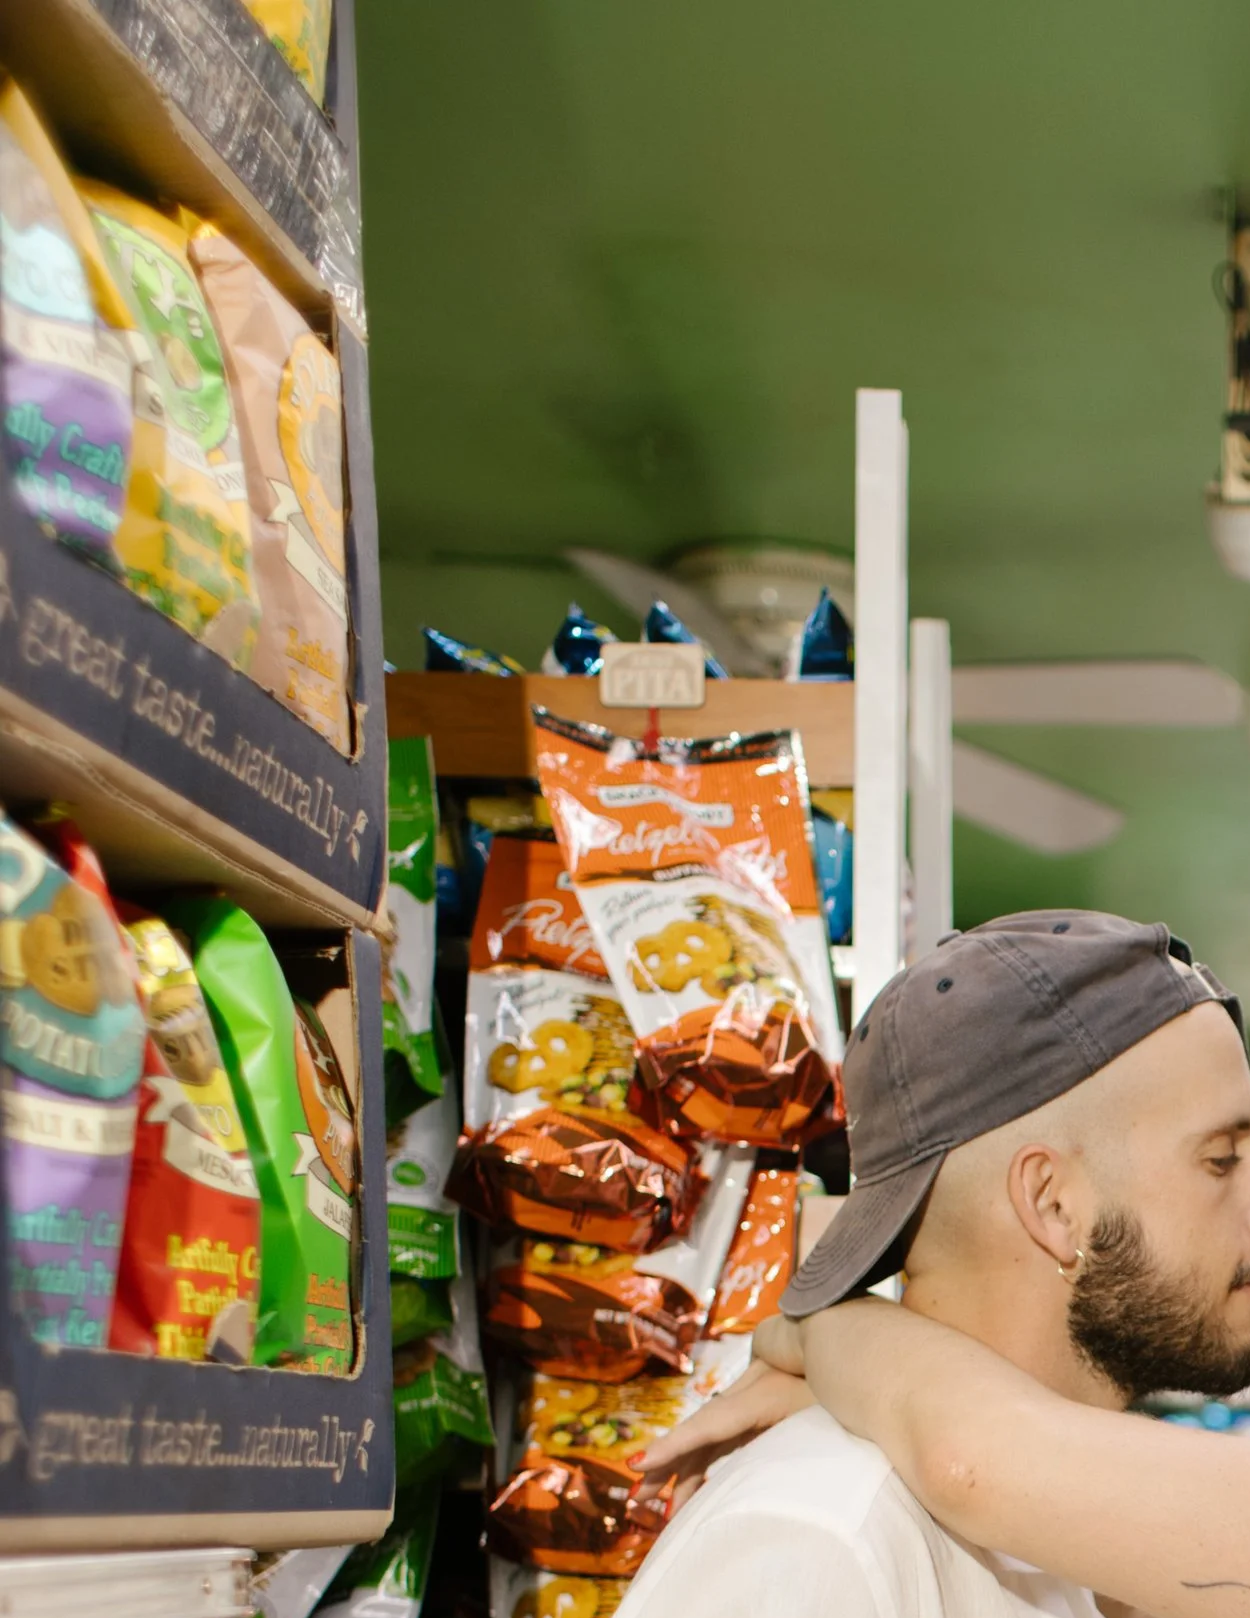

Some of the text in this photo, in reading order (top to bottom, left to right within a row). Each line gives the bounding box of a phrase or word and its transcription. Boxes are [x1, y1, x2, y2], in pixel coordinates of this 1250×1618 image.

[20, 597, 125, 700] great
[613, 667, 691, 699] PITA
[29, 1403, 134, 1481] great
